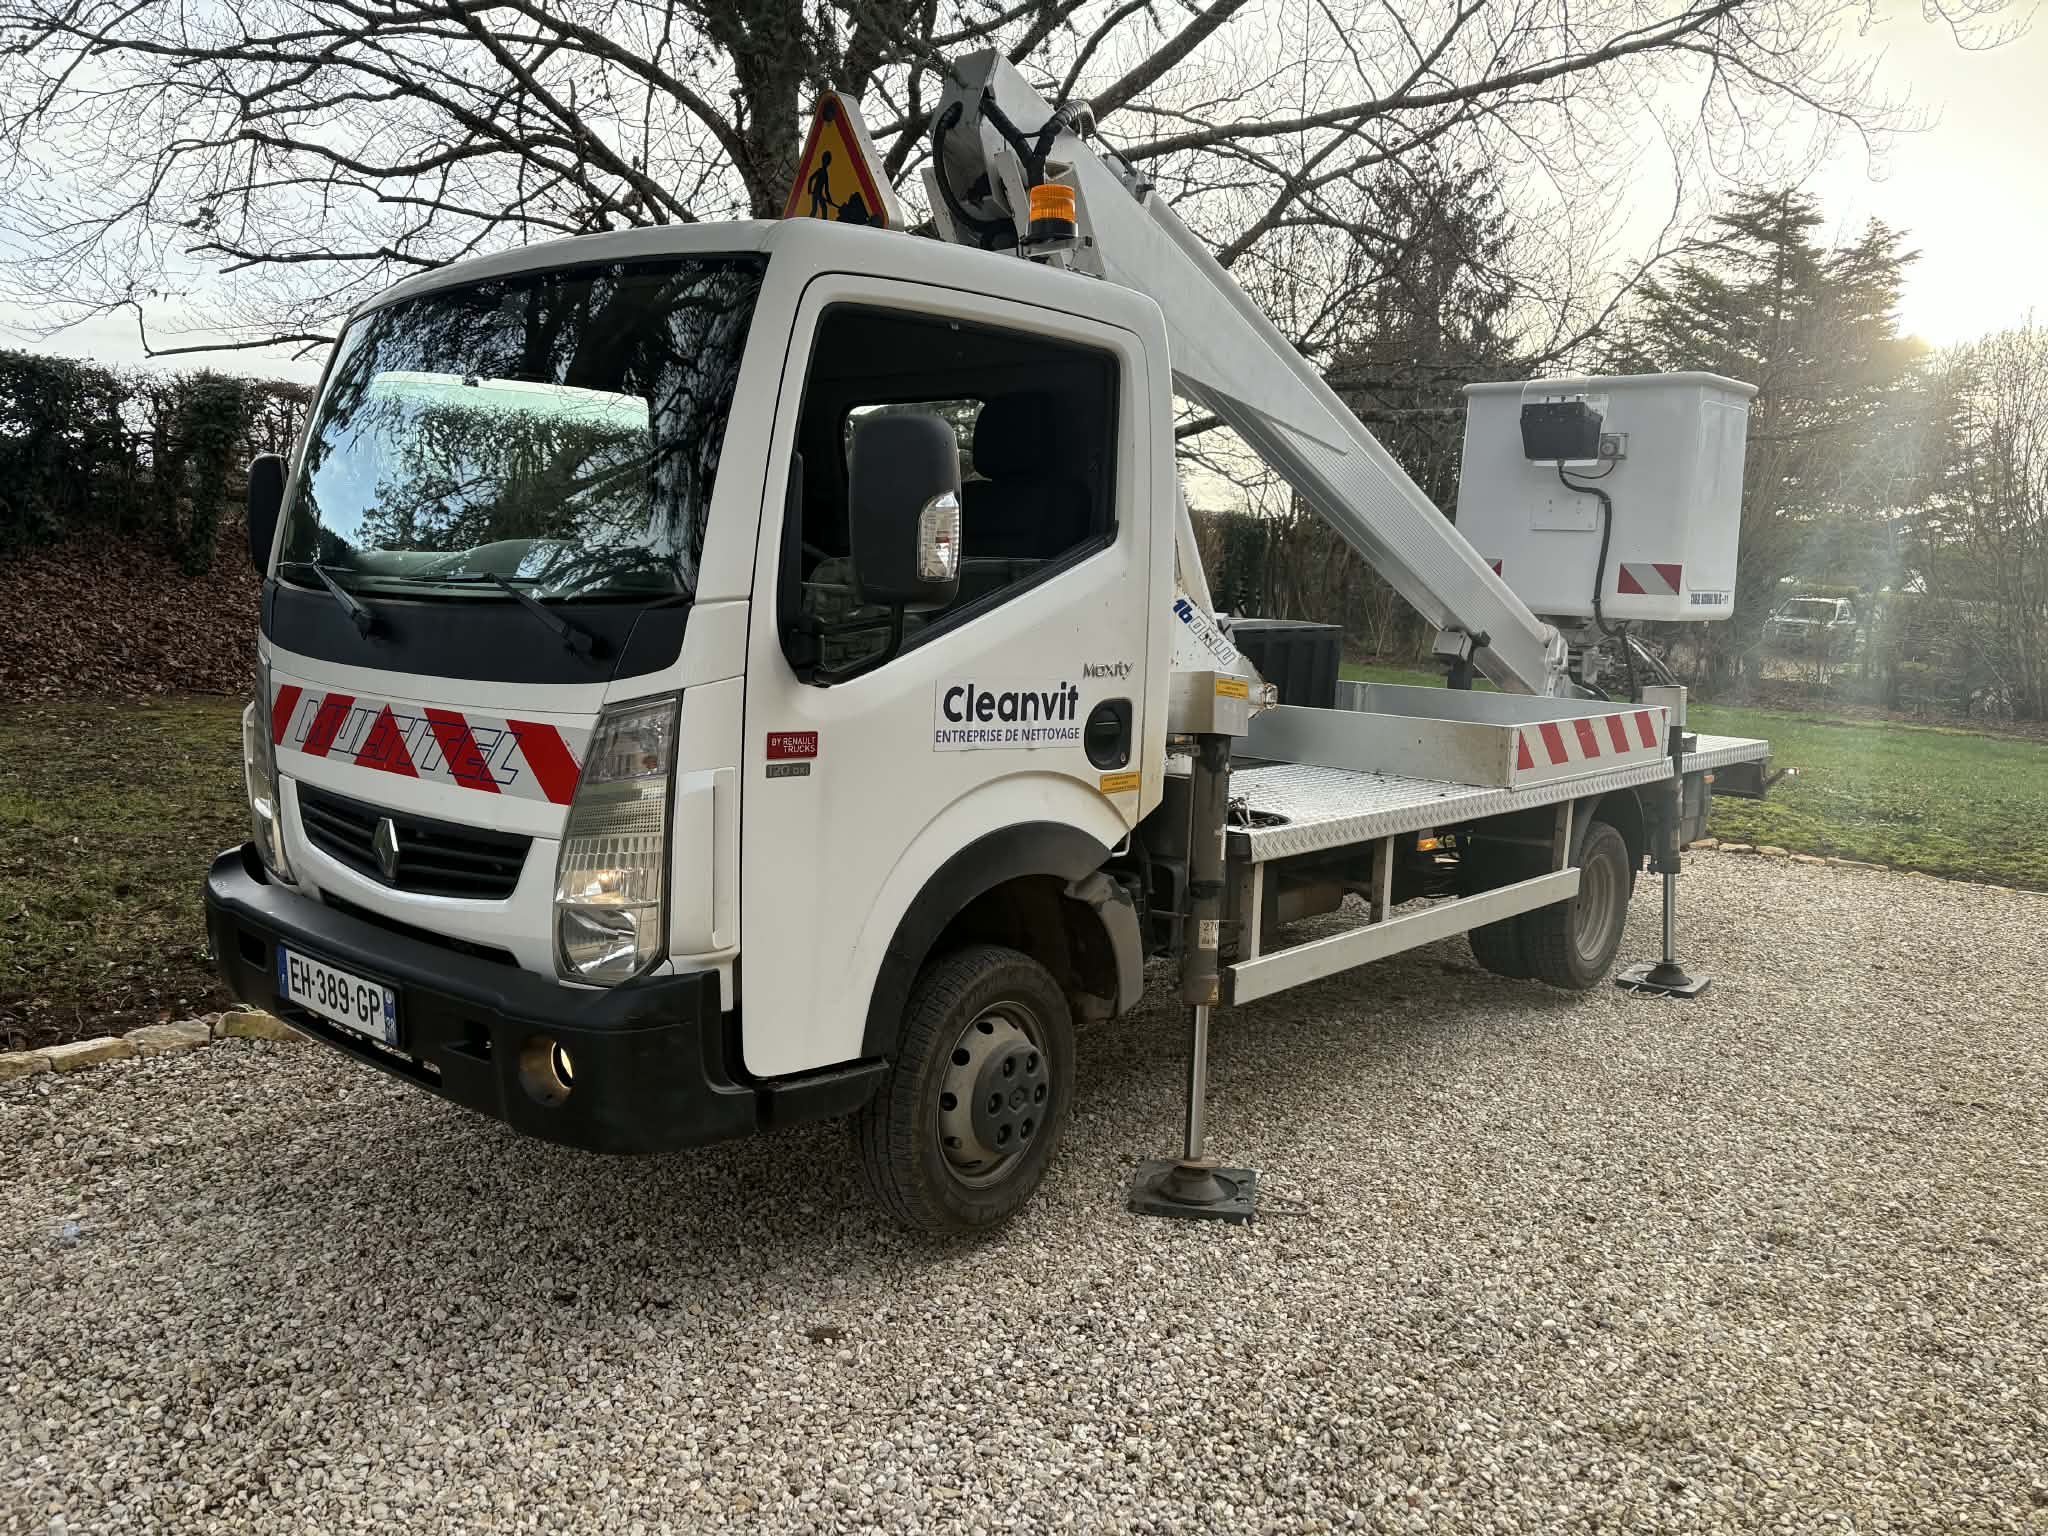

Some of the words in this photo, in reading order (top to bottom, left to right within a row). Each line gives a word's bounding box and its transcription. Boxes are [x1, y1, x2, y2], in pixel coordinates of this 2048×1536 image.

[943, 682, 1079, 722] Cleanvit
[295, 699, 522, 785] MULTITEL
[771, 737, 781, 746] BY
[783, 736, 816, 745] RENAULT
[783, 745, 816, 753] TRUCKS
[935, 729, 1003, 743] ENTREPRISE
[1005, 728, 1019, 742] DE
[1021, 727, 1080, 741] NETTOYAGE
[289, 956, 381, 1026] EH-389-GP
